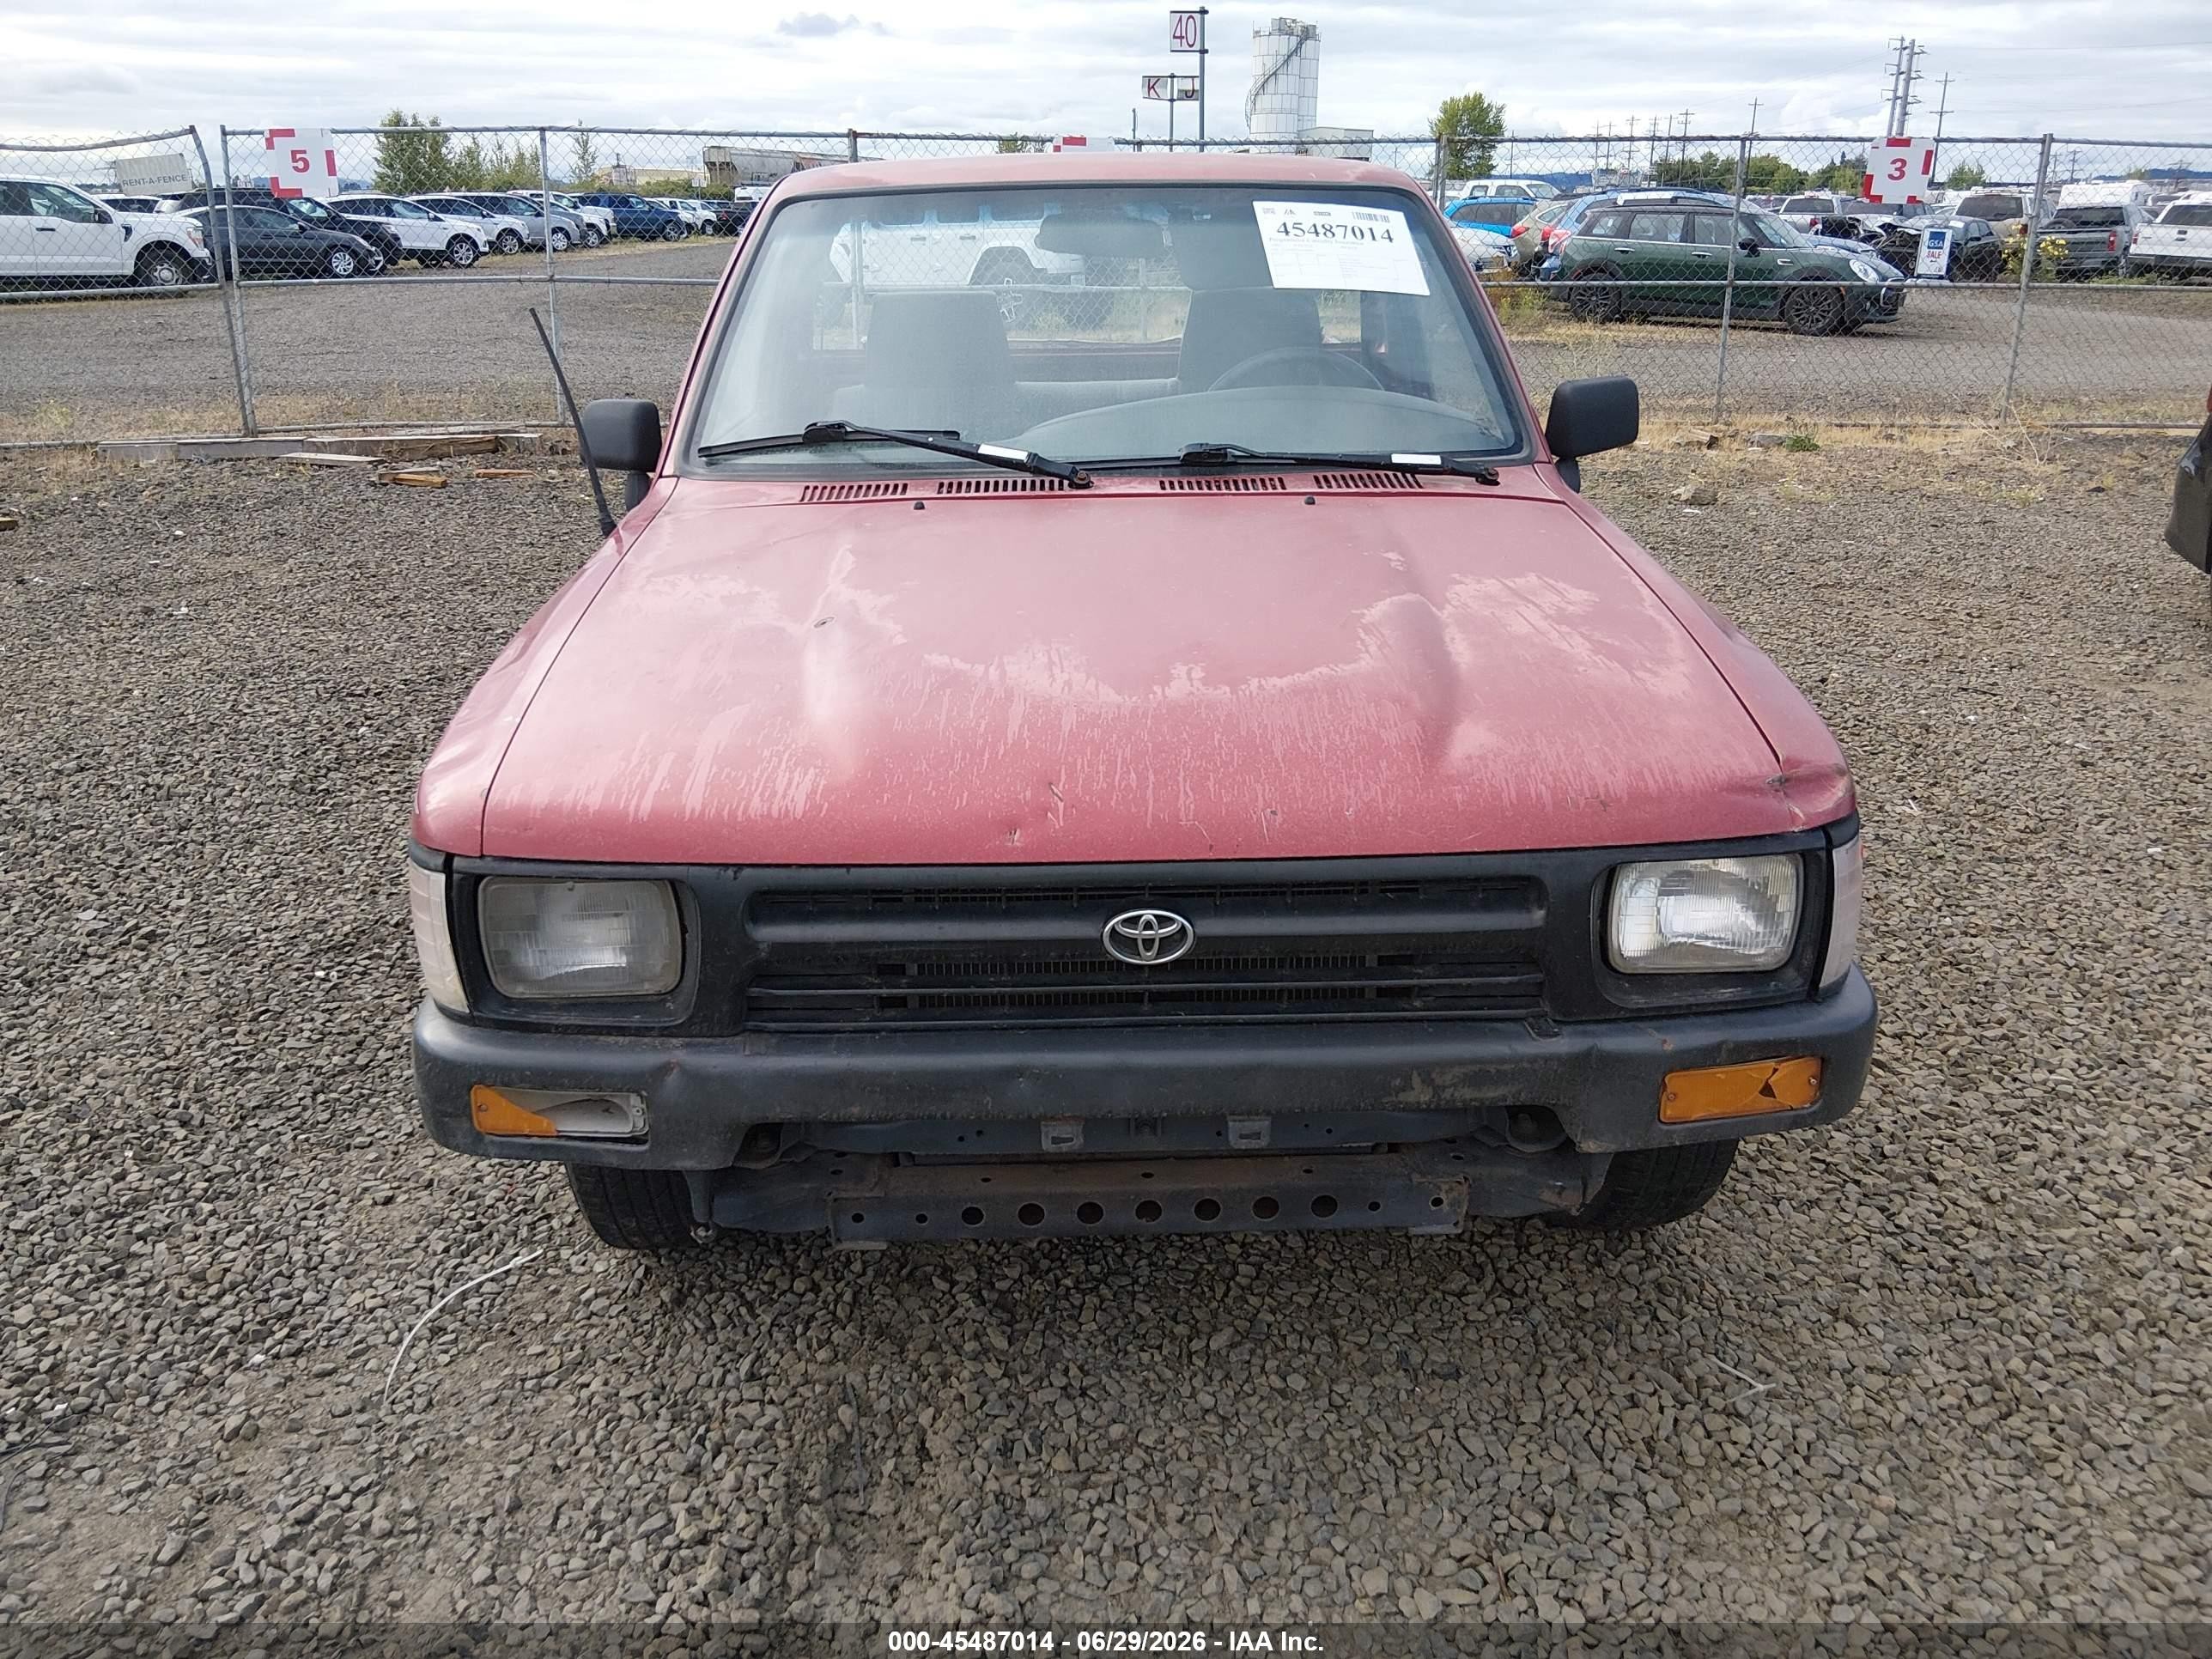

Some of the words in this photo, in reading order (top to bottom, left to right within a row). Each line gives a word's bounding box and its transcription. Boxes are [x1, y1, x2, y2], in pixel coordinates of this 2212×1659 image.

[1173, 15, 1196, 48] 40
[1147, 78, 1160, 98] K
[1185, 77, 1195, 99] J
[291, 149, 310, 173] 5
[1887, 158, 1907, 181] 3
[122, 174, 187, 186] RENT-A-FENCE
[1277, 222, 1394, 243] 45487014
[1926, 250, 1942, 258] SALE
